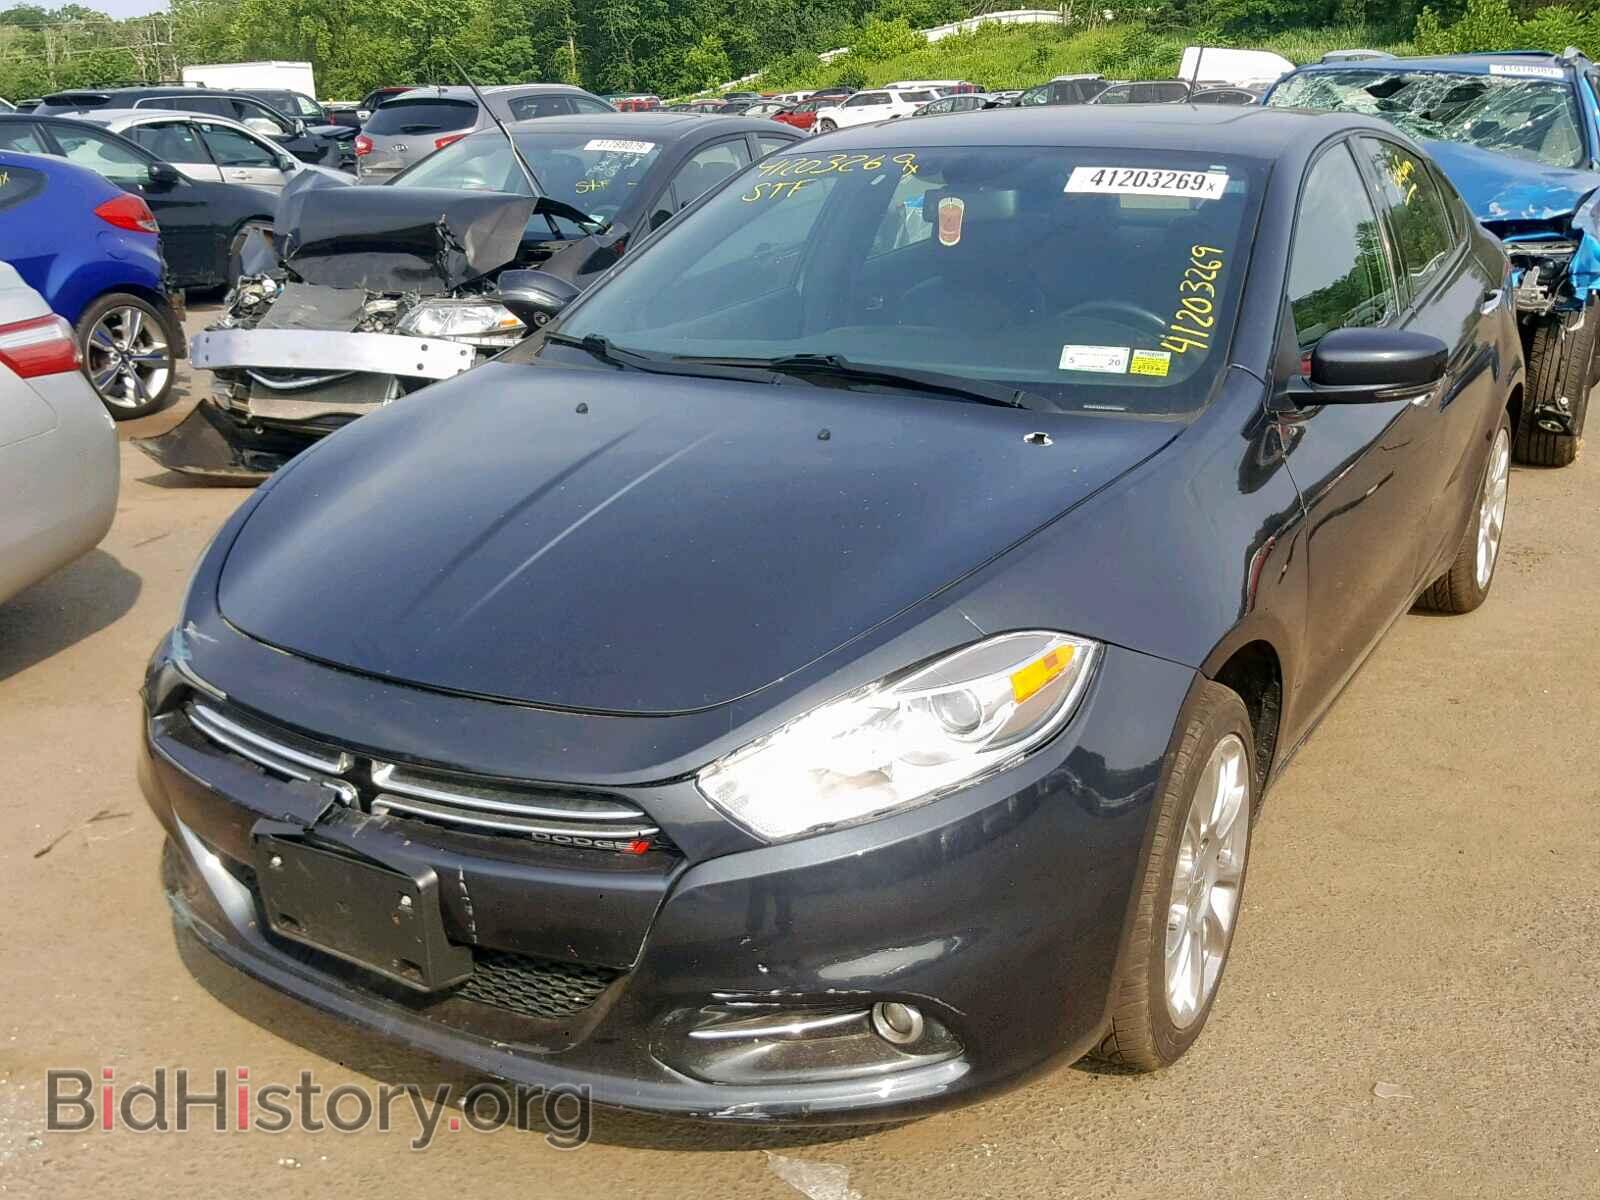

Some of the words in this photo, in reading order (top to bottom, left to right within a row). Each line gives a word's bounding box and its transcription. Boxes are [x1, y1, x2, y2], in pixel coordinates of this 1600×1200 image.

[742, 177, 816, 201] STF
[1160, 244, 1224, 353] 41203269
[531, 831, 631, 850] DODGE
